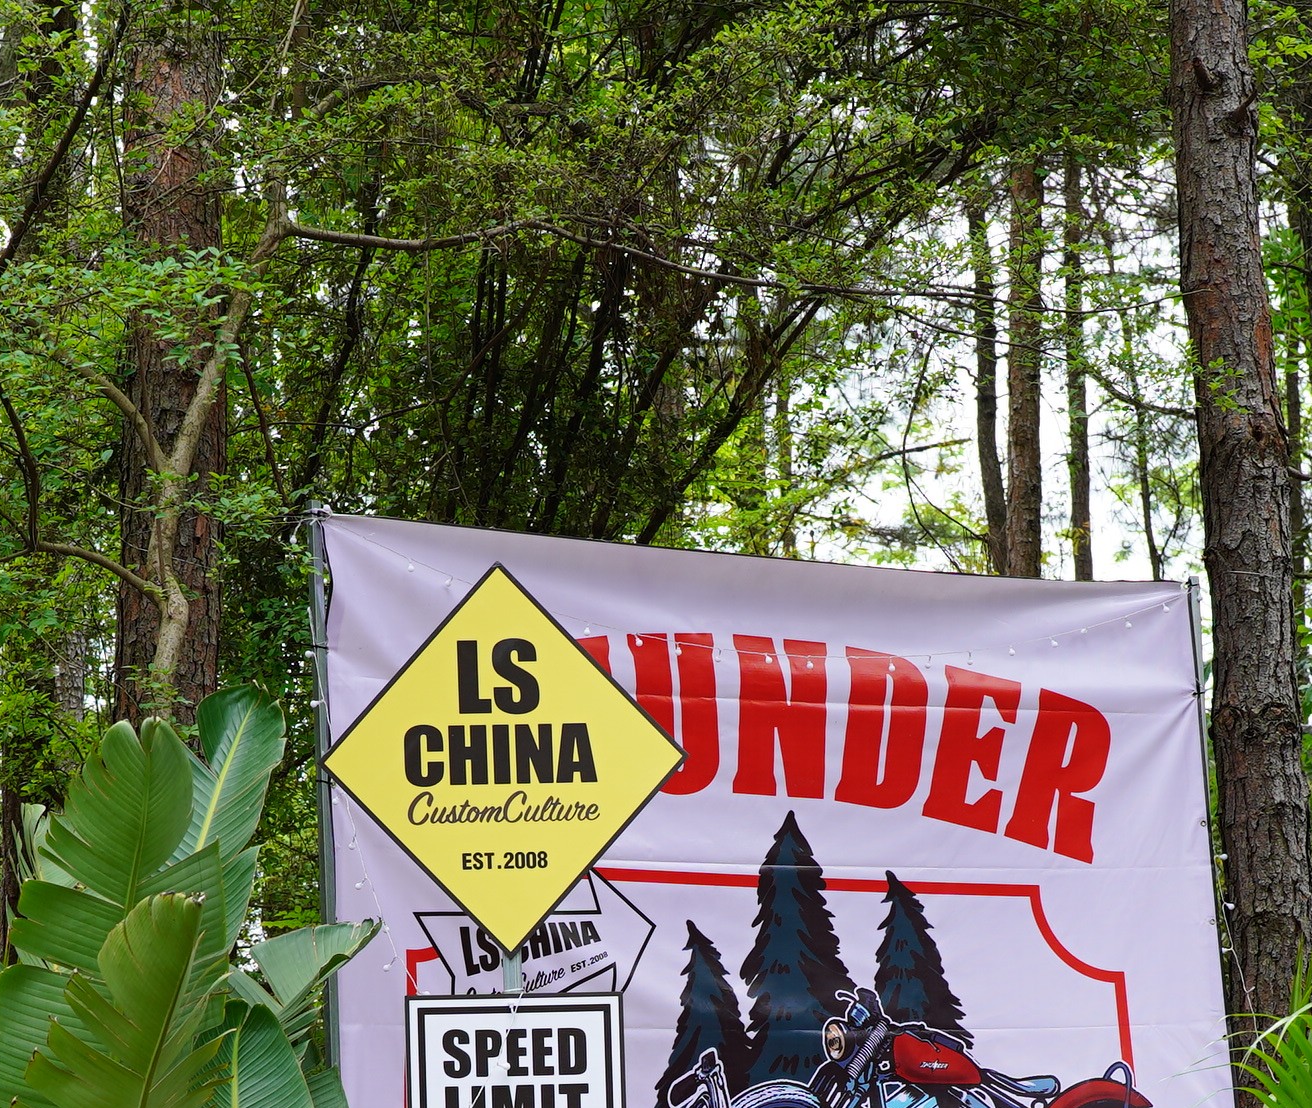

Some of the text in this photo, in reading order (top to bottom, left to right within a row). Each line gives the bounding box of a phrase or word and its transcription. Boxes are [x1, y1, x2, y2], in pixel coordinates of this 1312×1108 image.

[456, 637, 540, 715] LS
[403, 722, 598, 788] CHINA
[573, 632, 1112, 864] UNDER
[407, 790, 601, 826] CustomCulture
[461, 850, 548, 871] EST.2008
[442, 1027, 588, 1079] SPEED
